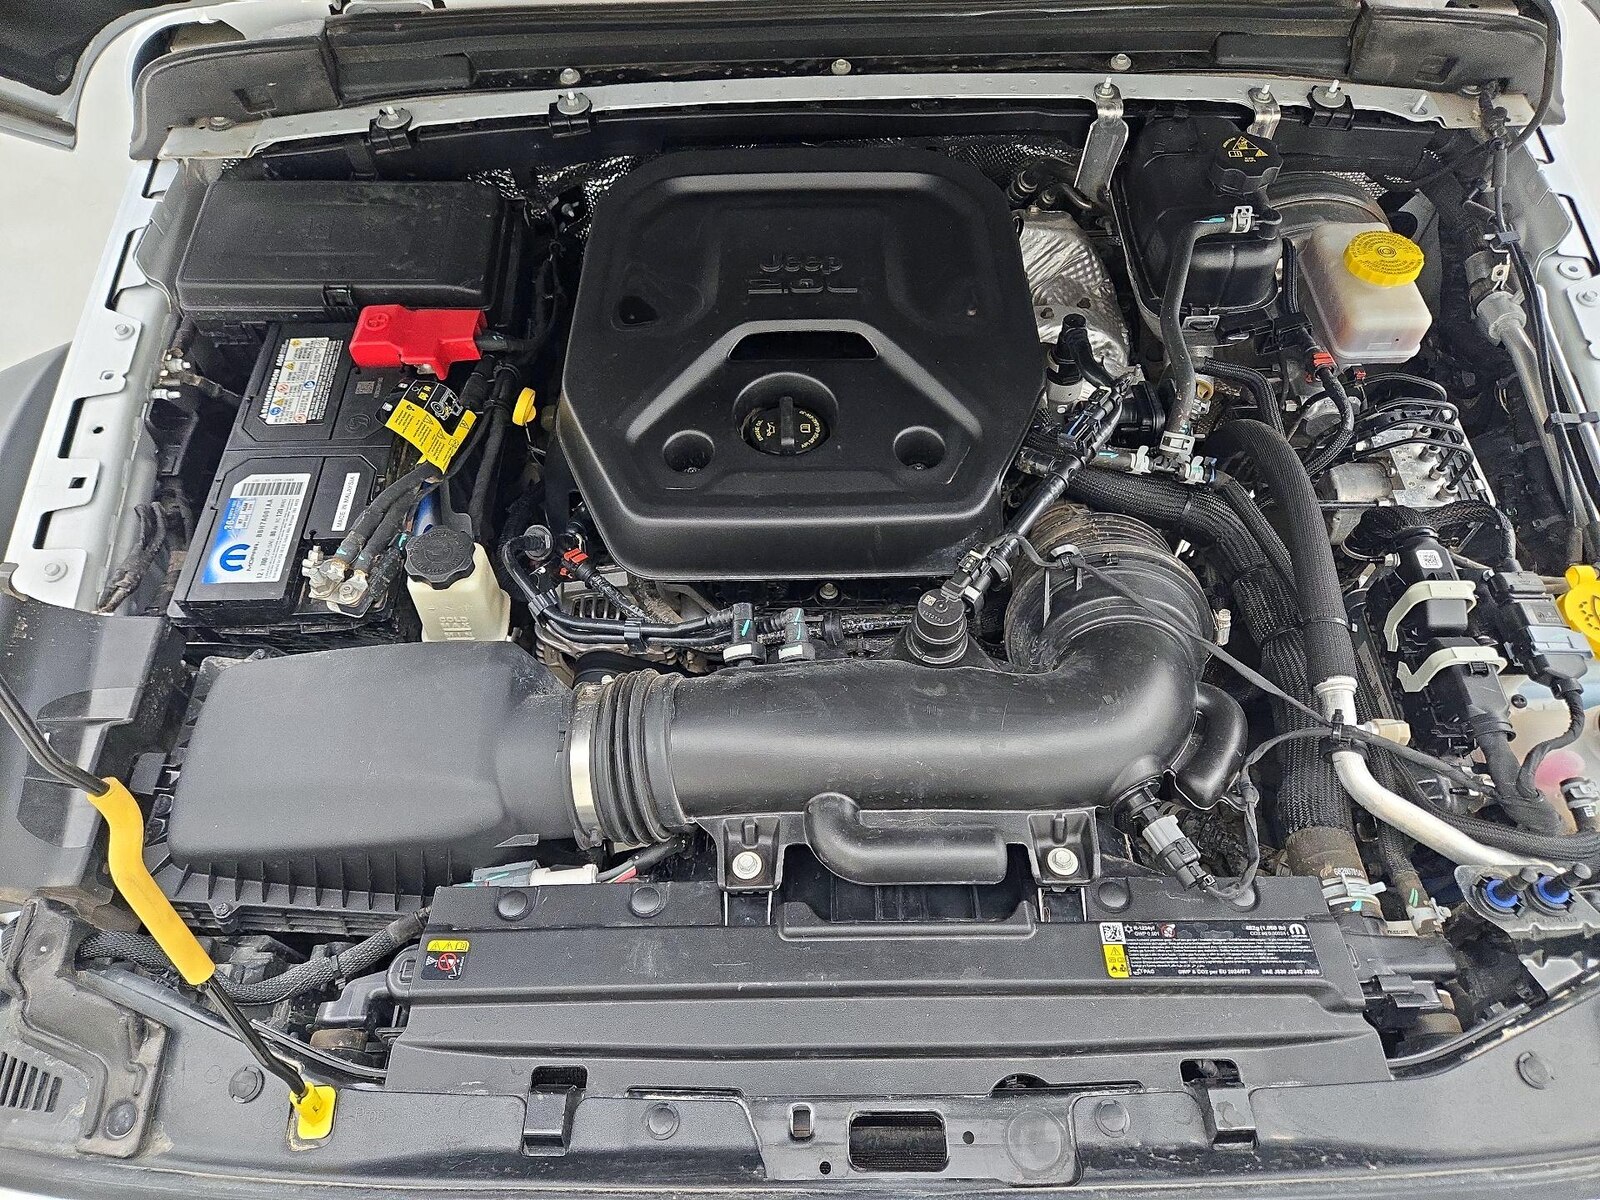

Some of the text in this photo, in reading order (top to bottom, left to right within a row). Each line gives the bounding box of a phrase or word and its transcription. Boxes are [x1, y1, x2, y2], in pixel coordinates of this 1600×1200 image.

[759, 254, 843, 275] Jeep
[337, 511, 345, 527] MADE
[344, 475, 355, 503] MALAYSIA
